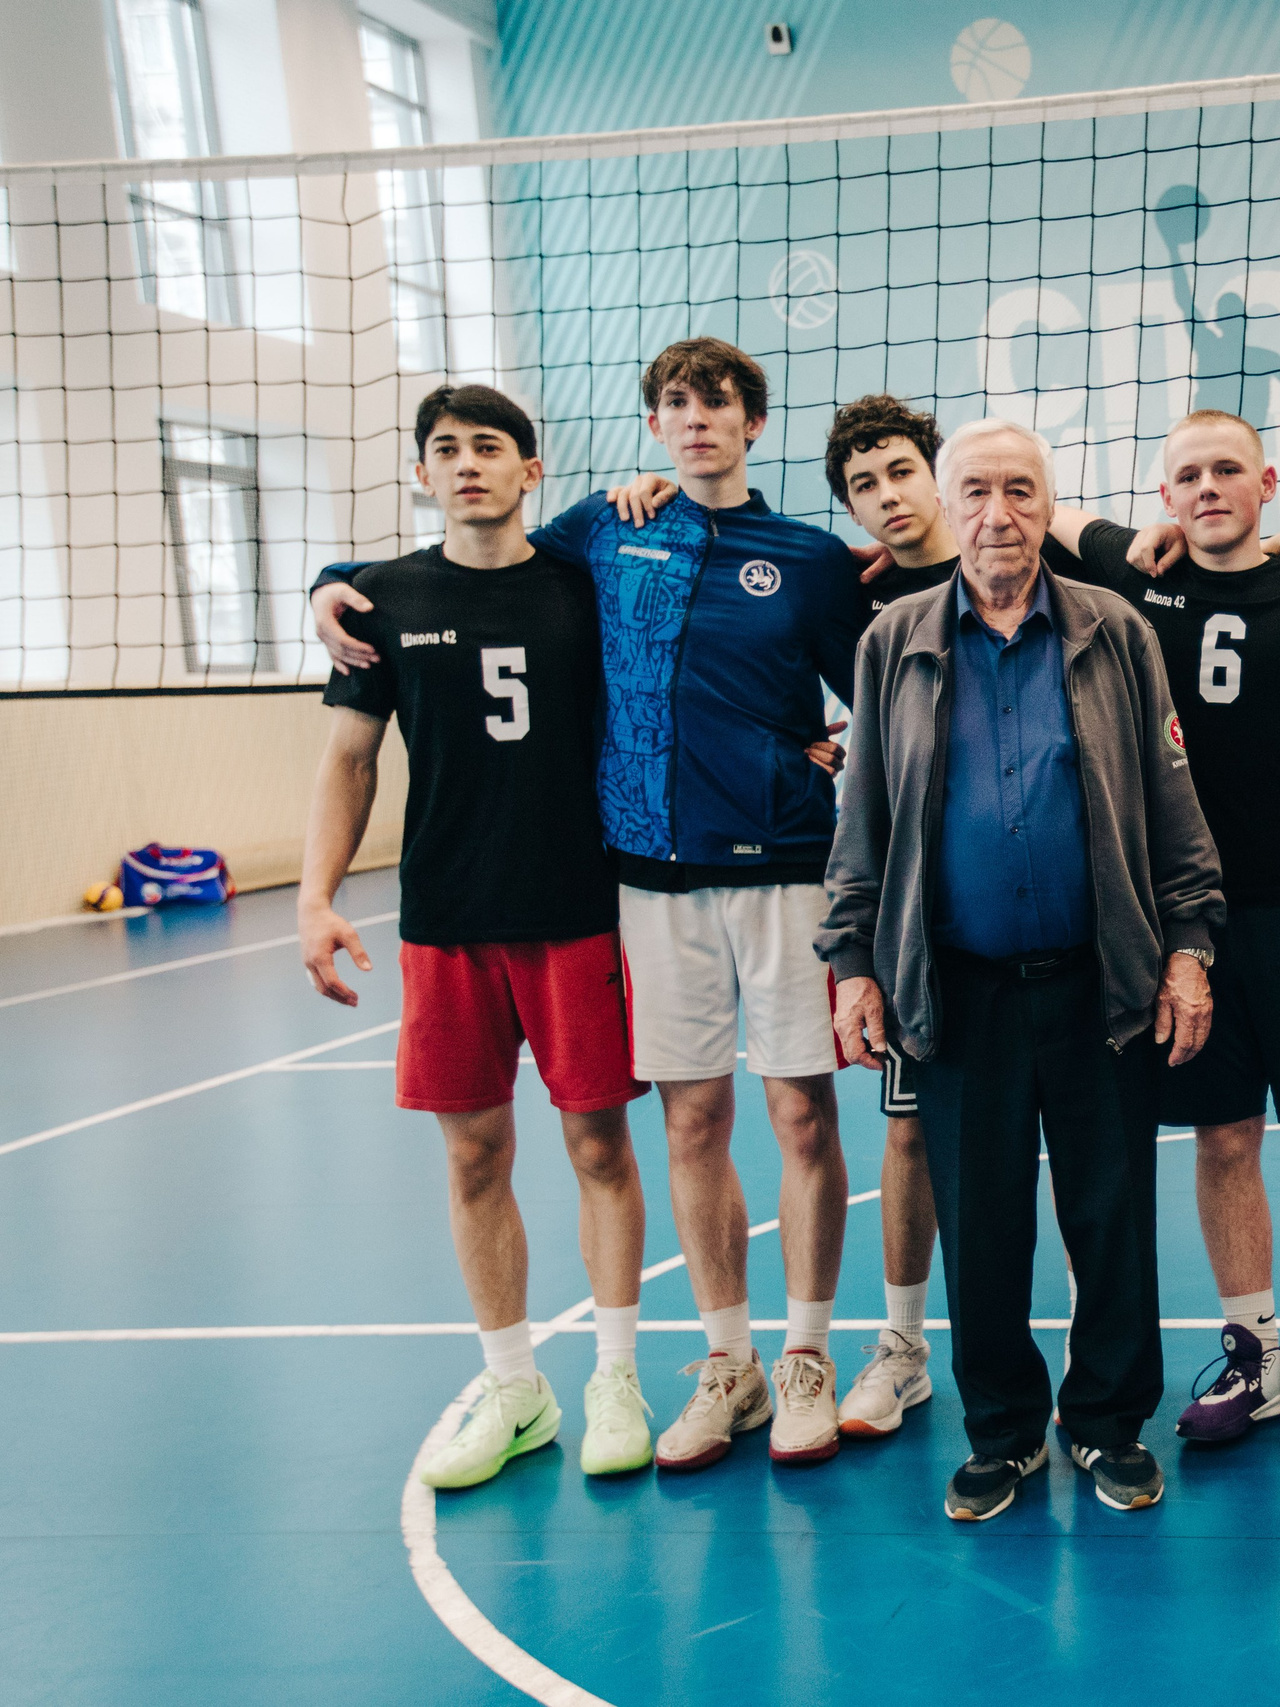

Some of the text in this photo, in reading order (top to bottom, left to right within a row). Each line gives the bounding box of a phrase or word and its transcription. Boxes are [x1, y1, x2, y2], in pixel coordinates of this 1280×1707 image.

[1144, 588, 1186, 609] Школа 42
[400, 629, 457, 648] Школа 42
[1199, 613, 1247, 704] 6
[481, 646, 531, 742] 5
